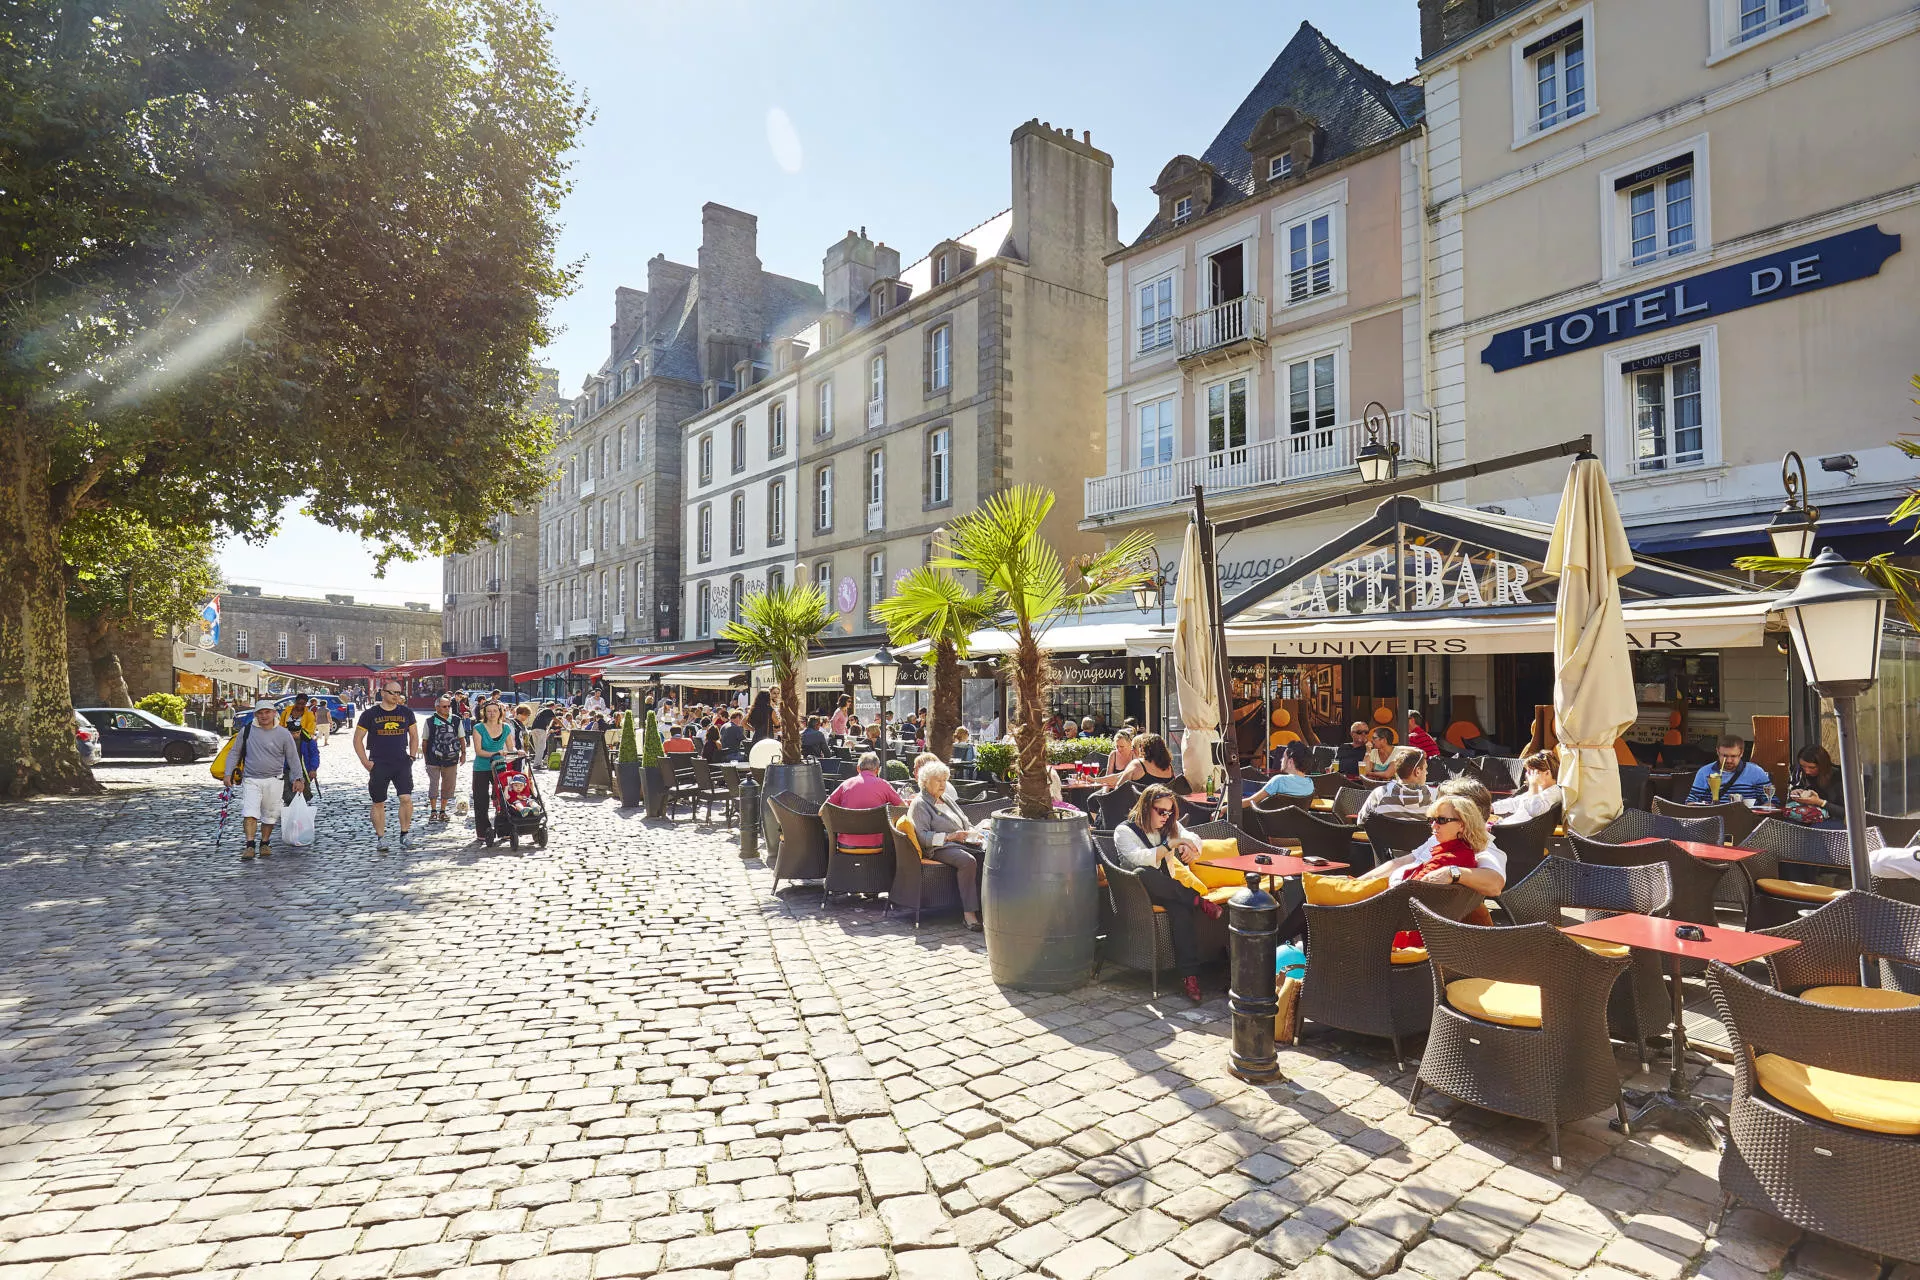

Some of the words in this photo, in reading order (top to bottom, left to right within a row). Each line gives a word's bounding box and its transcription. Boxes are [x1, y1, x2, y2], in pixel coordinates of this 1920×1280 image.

[1635, 162, 1671, 180] HOTEL
[1523, 284, 1708, 358] HOTEL
[1749, 253, 1821, 297] DE
[1409, 544, 1532, 611] BAR
[1272, 638, 1467, 656] L'UNIVERS
[1625, 631, 1683, 649] AR
[1064, 664, 1125, 684] Voyageurs
